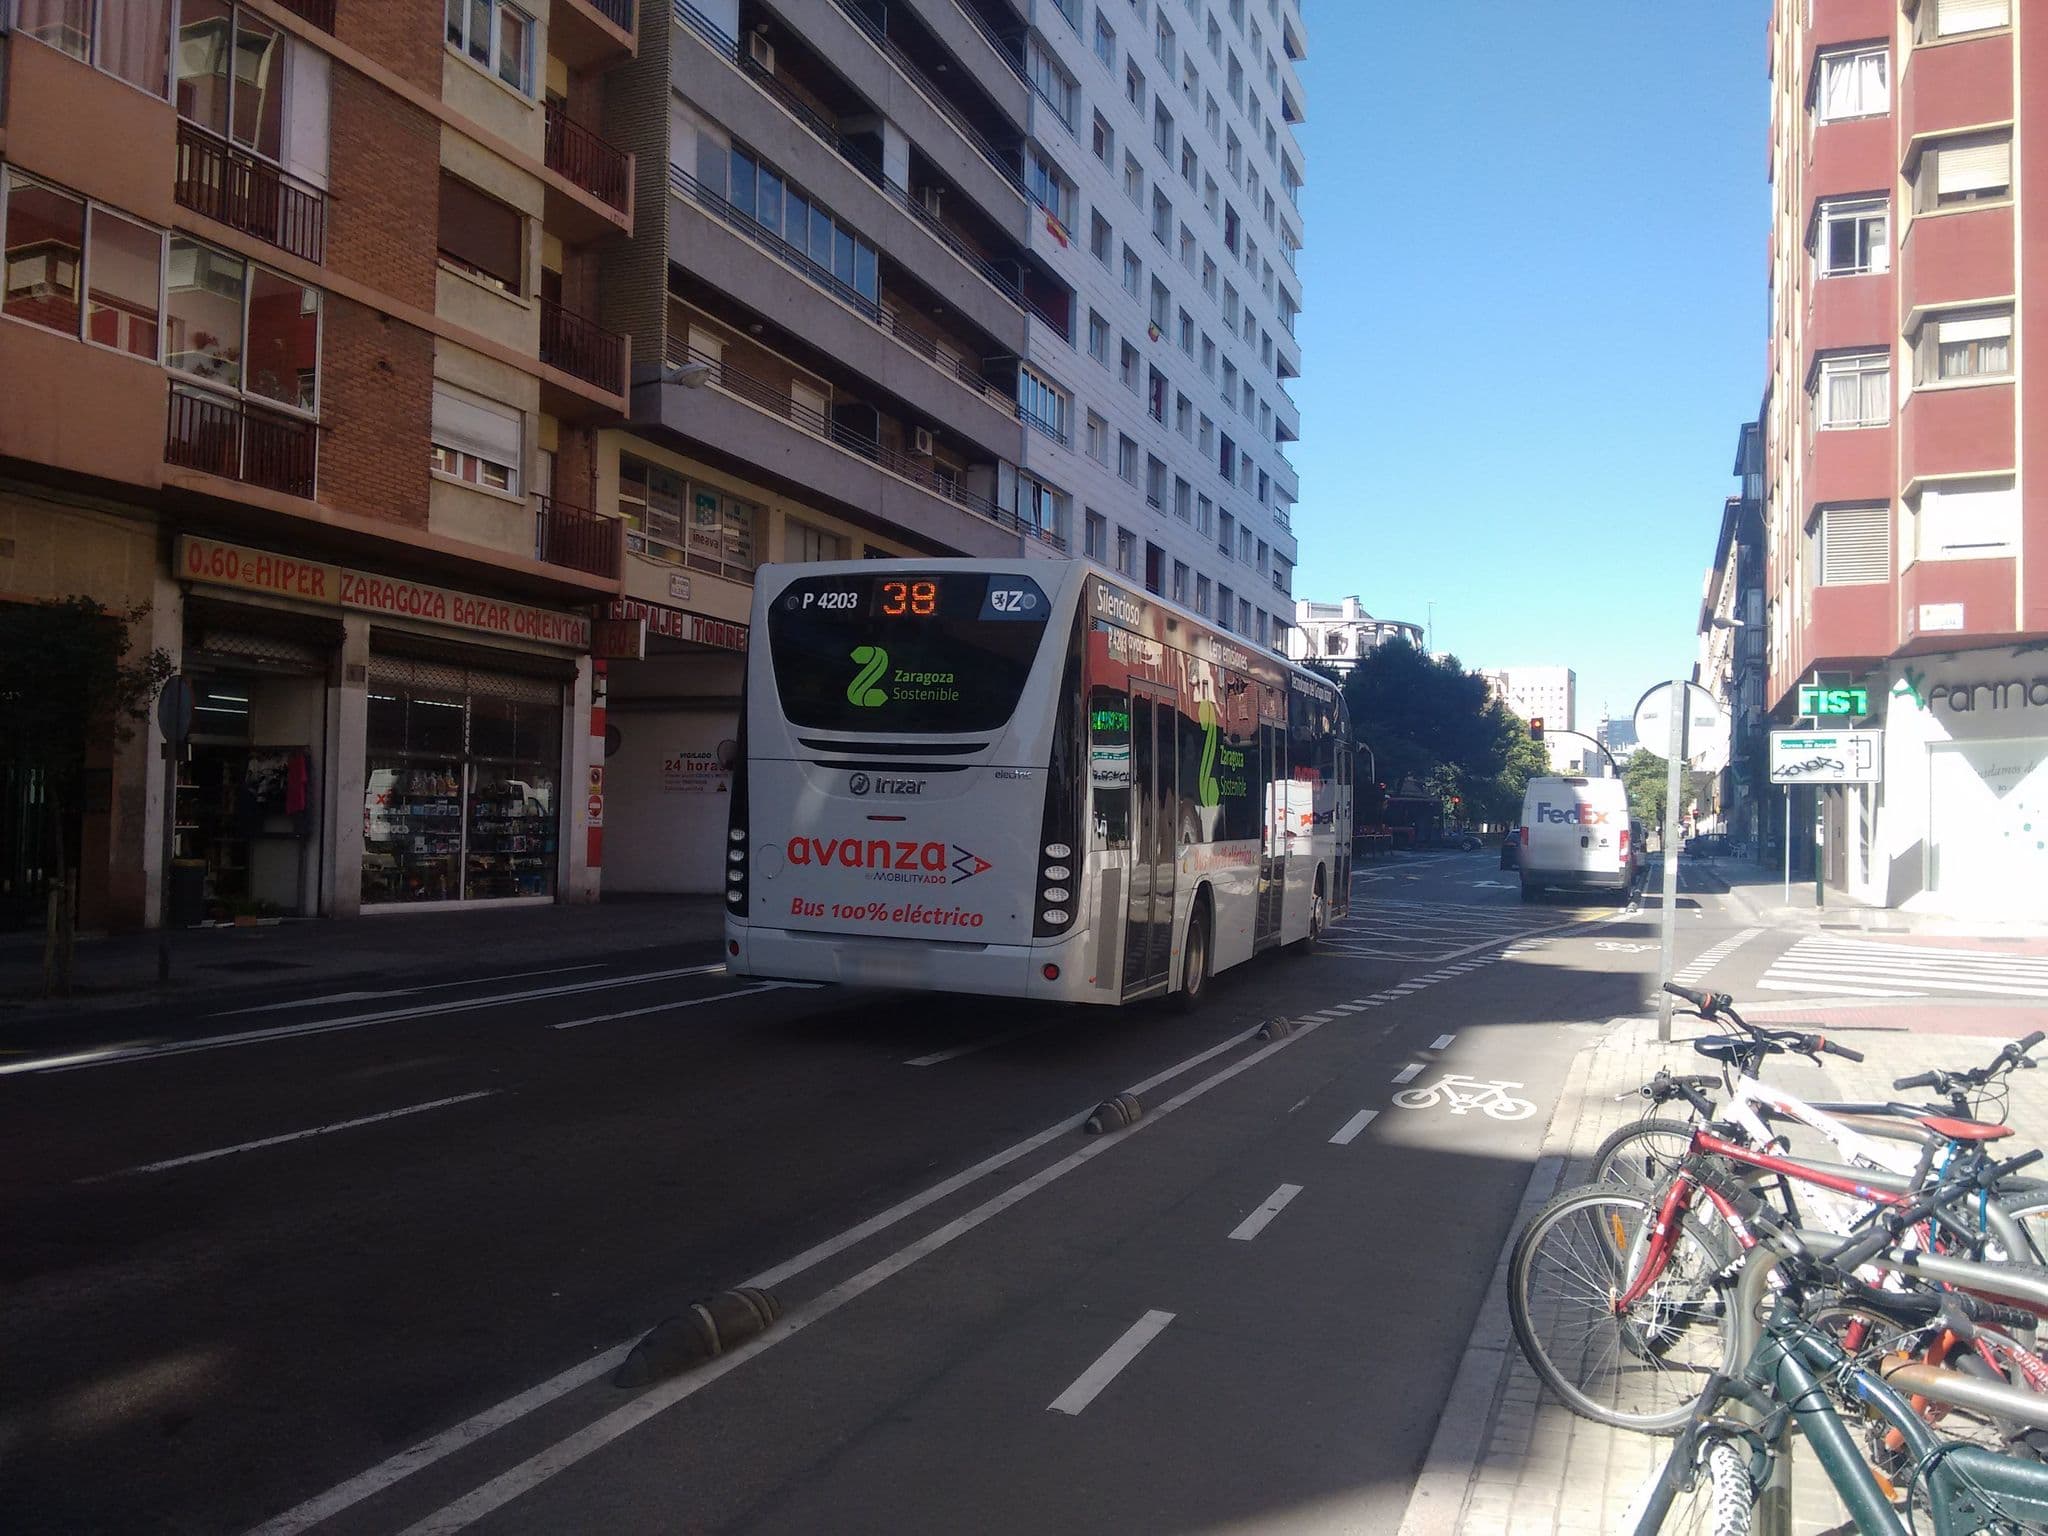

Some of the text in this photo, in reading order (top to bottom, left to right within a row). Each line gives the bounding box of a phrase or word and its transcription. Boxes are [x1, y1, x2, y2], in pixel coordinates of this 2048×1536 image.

[256, 553, 326, 599] HIPER
[340, 572, 589, 646] ZARAGOZA BAZAR ORIENTAL
[802, 591, 859, 610] P 4203
[881, 581, 937, 617] 38
[1097, 584, 1141, 627] Silencioso
[894, 669, 955, 687] Zaragoza
[892, 687, 960, 702] Sostenible
[664, 759, 681, 771] 24
[679, 751, 713, 760] VIGILADO
[1219, 745, 1244, 772] Zaragoza
[875, 776, 927, 795] irizar
[1537, 801, 1609, 825] FedEx
[787, 836, 947, 871] avanza
[790, 897, 984, 929] Bus 100% eléctrico
